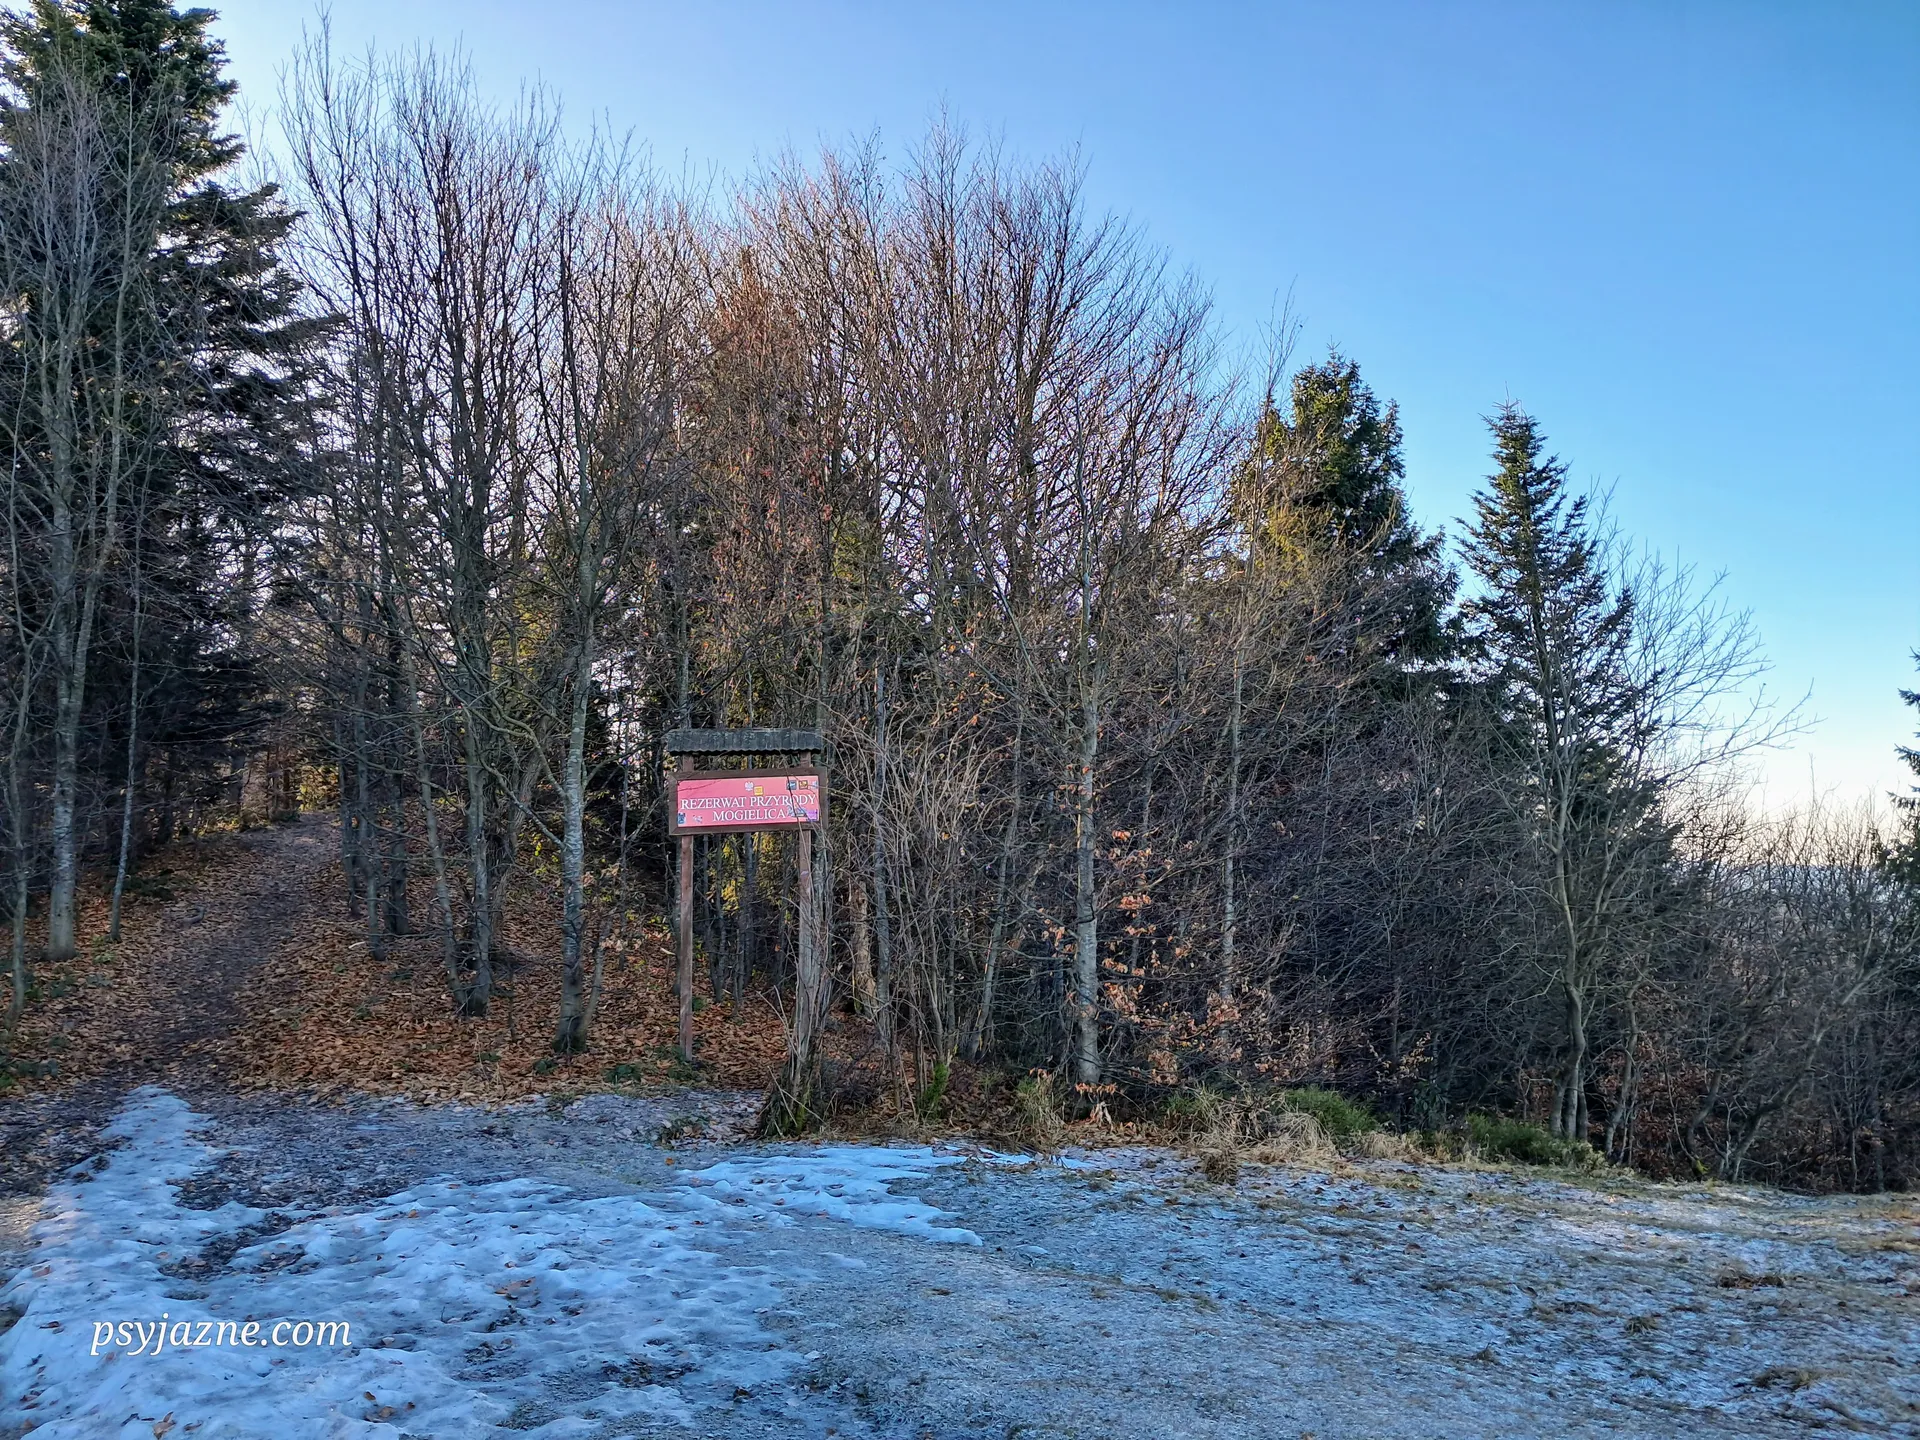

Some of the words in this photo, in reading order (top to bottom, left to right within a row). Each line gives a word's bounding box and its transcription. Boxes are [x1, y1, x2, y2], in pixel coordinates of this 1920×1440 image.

[680, 797, 747, 810] REZERWAT
[750, 794, 816, 807] PRZYRODY
[712, 808, 786, 822] MOGIELICA
